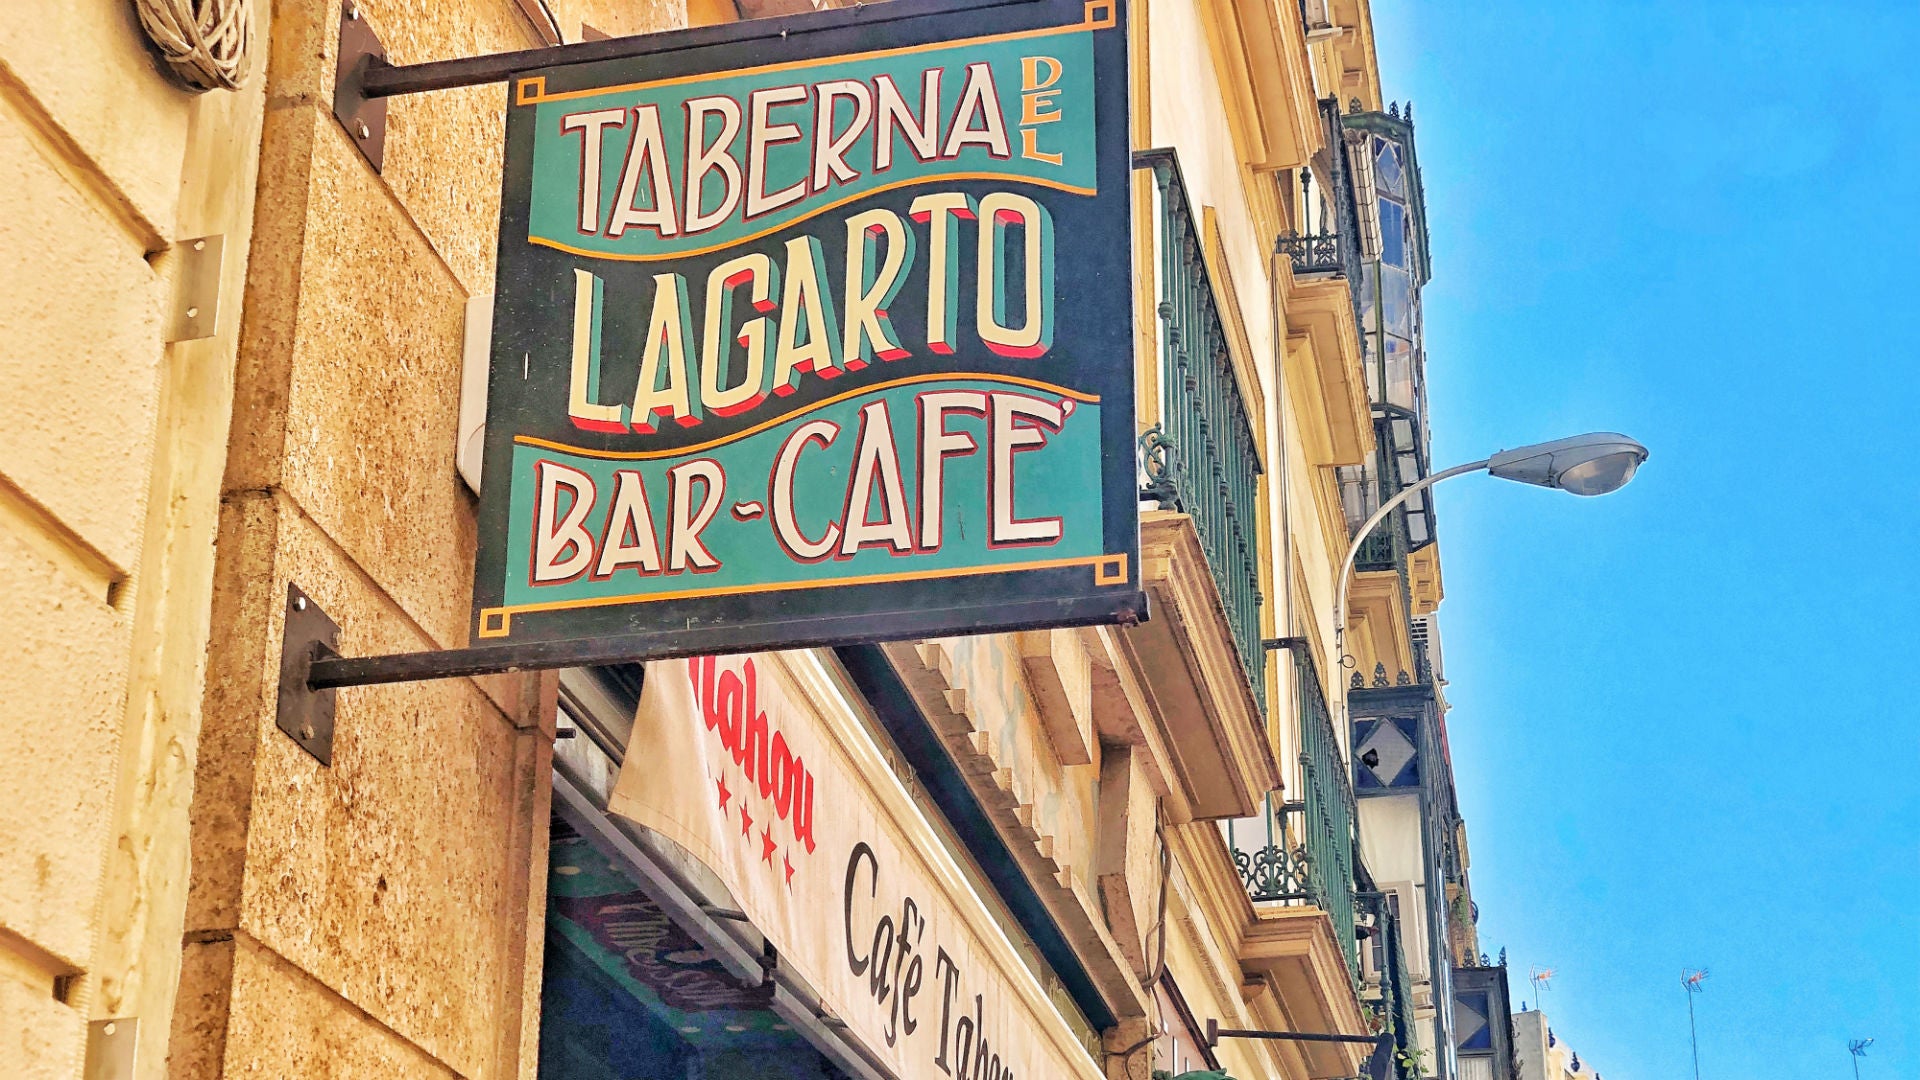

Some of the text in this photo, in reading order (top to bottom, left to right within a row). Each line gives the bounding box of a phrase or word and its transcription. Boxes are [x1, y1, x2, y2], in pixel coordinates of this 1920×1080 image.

[561, 62, 1011, 240] TABERNA
[1018, 56, 1064, 166] DEL
[567, 191, 1056, 434] LAGARTO
[844, 841, 925, 1049] Café
